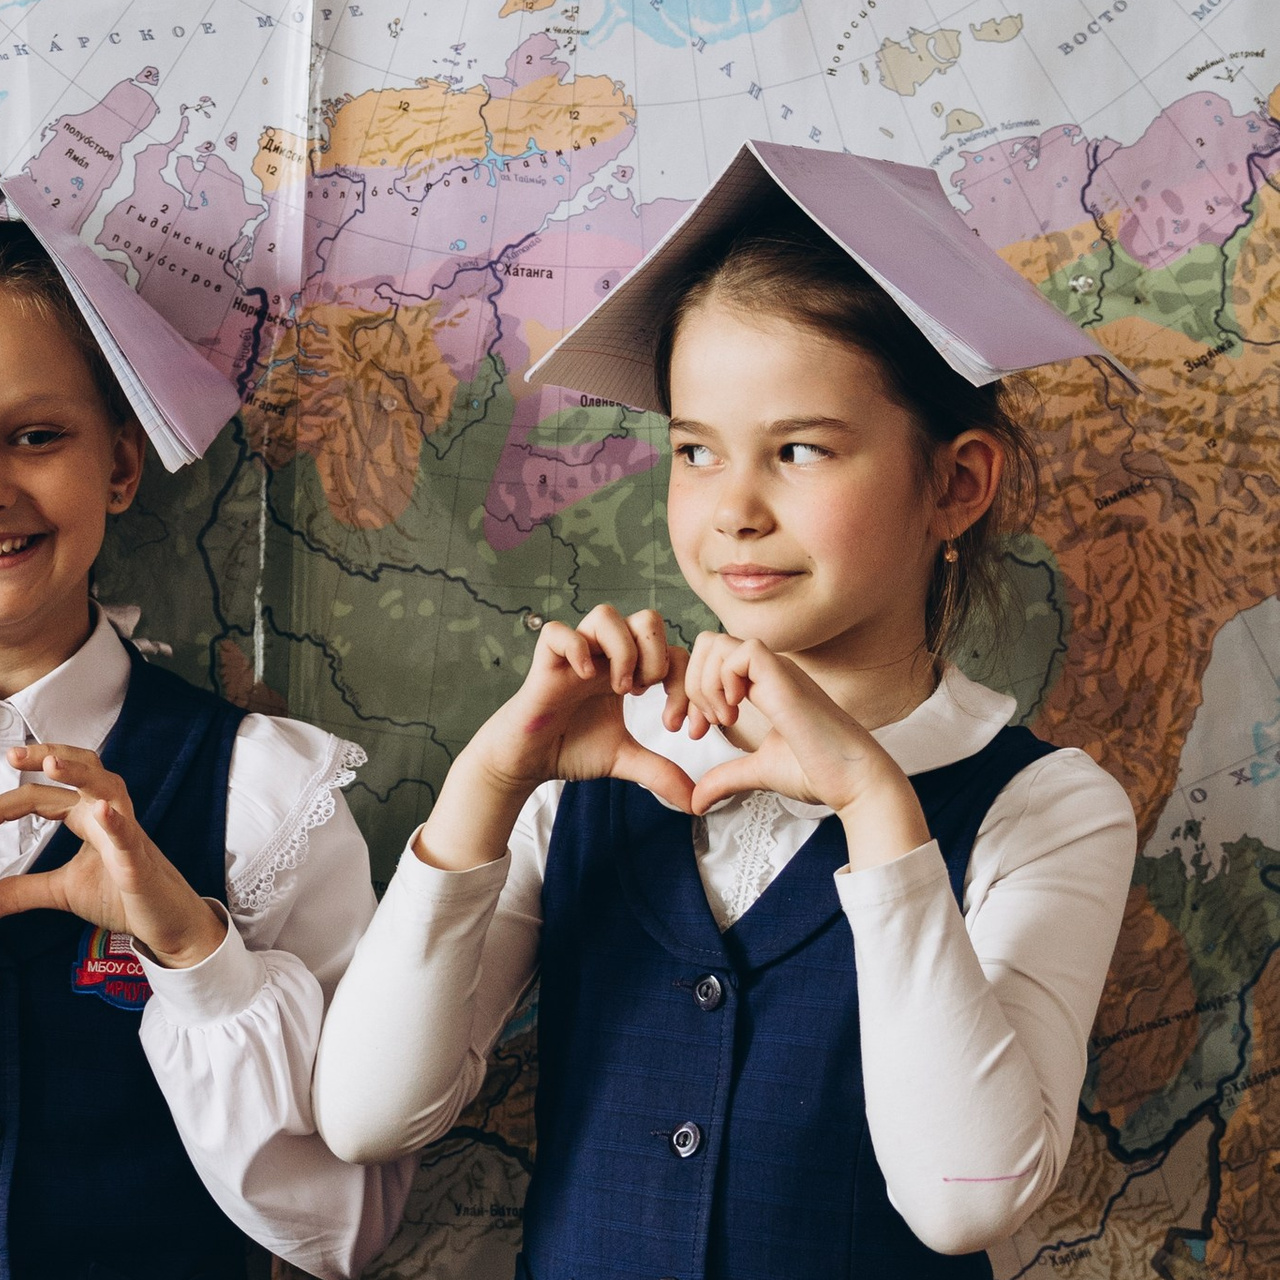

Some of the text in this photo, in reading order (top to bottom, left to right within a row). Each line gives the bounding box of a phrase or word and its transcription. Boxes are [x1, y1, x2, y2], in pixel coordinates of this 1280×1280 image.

[87, 961, 145, 975] МБОУ СО
[105, 981, 154, 1002] ИРКУТ
